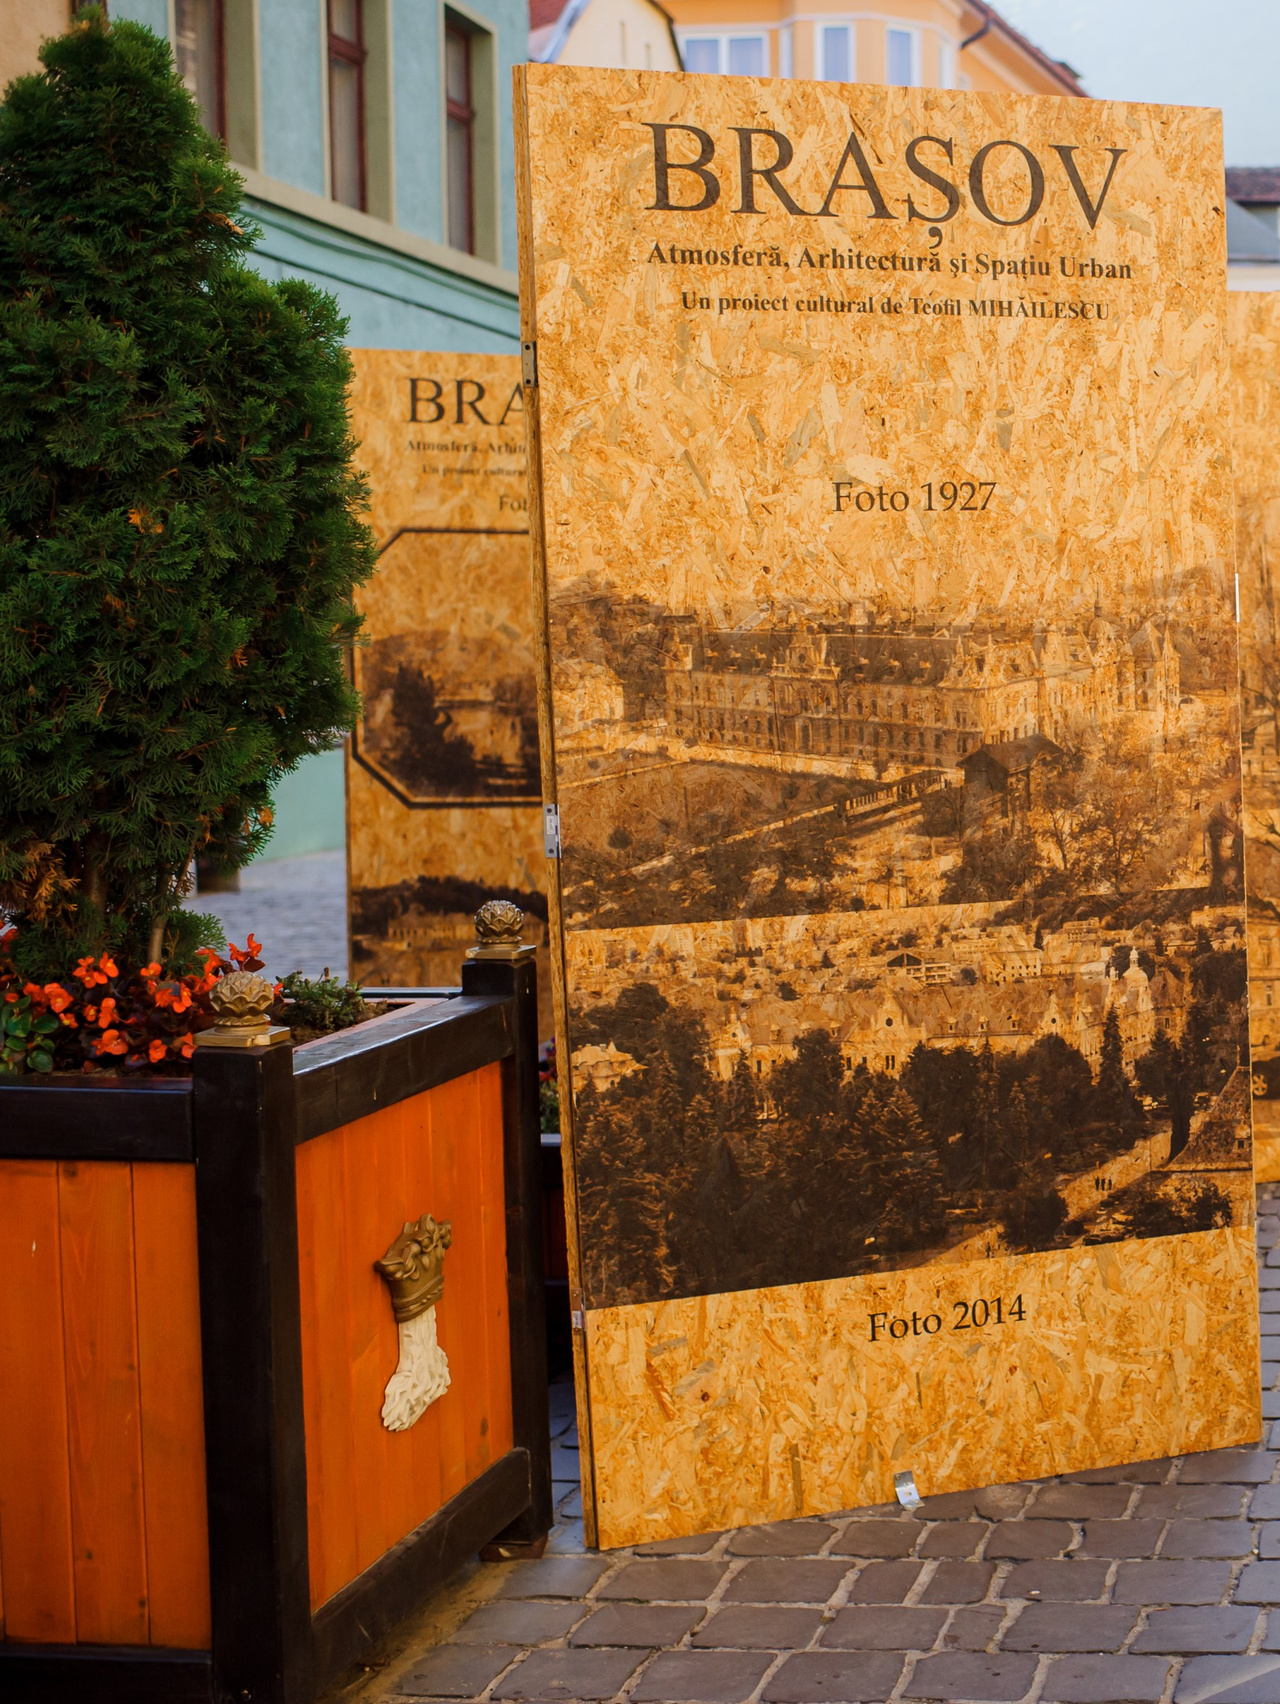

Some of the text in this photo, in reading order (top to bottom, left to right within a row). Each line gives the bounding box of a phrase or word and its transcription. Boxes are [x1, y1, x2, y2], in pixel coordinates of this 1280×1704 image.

[642, 121, 1129, 247] BRAȘOV
[647, 242, 791, 272] Atmosferă,
[797, 247, 942, 273] Arhitectură
[1059, 255, 1132, 279] Urban
[681, 291, 1110, 320] Un proiect cultural de Teofil MIHĂILESCU
[409, 377, 524, 425] BRA
[499, 494, 527, 512] Fot
[832, 481, 998, 512] Foto 1927
[867, 1293, 1027, 1342] Foto 2014
